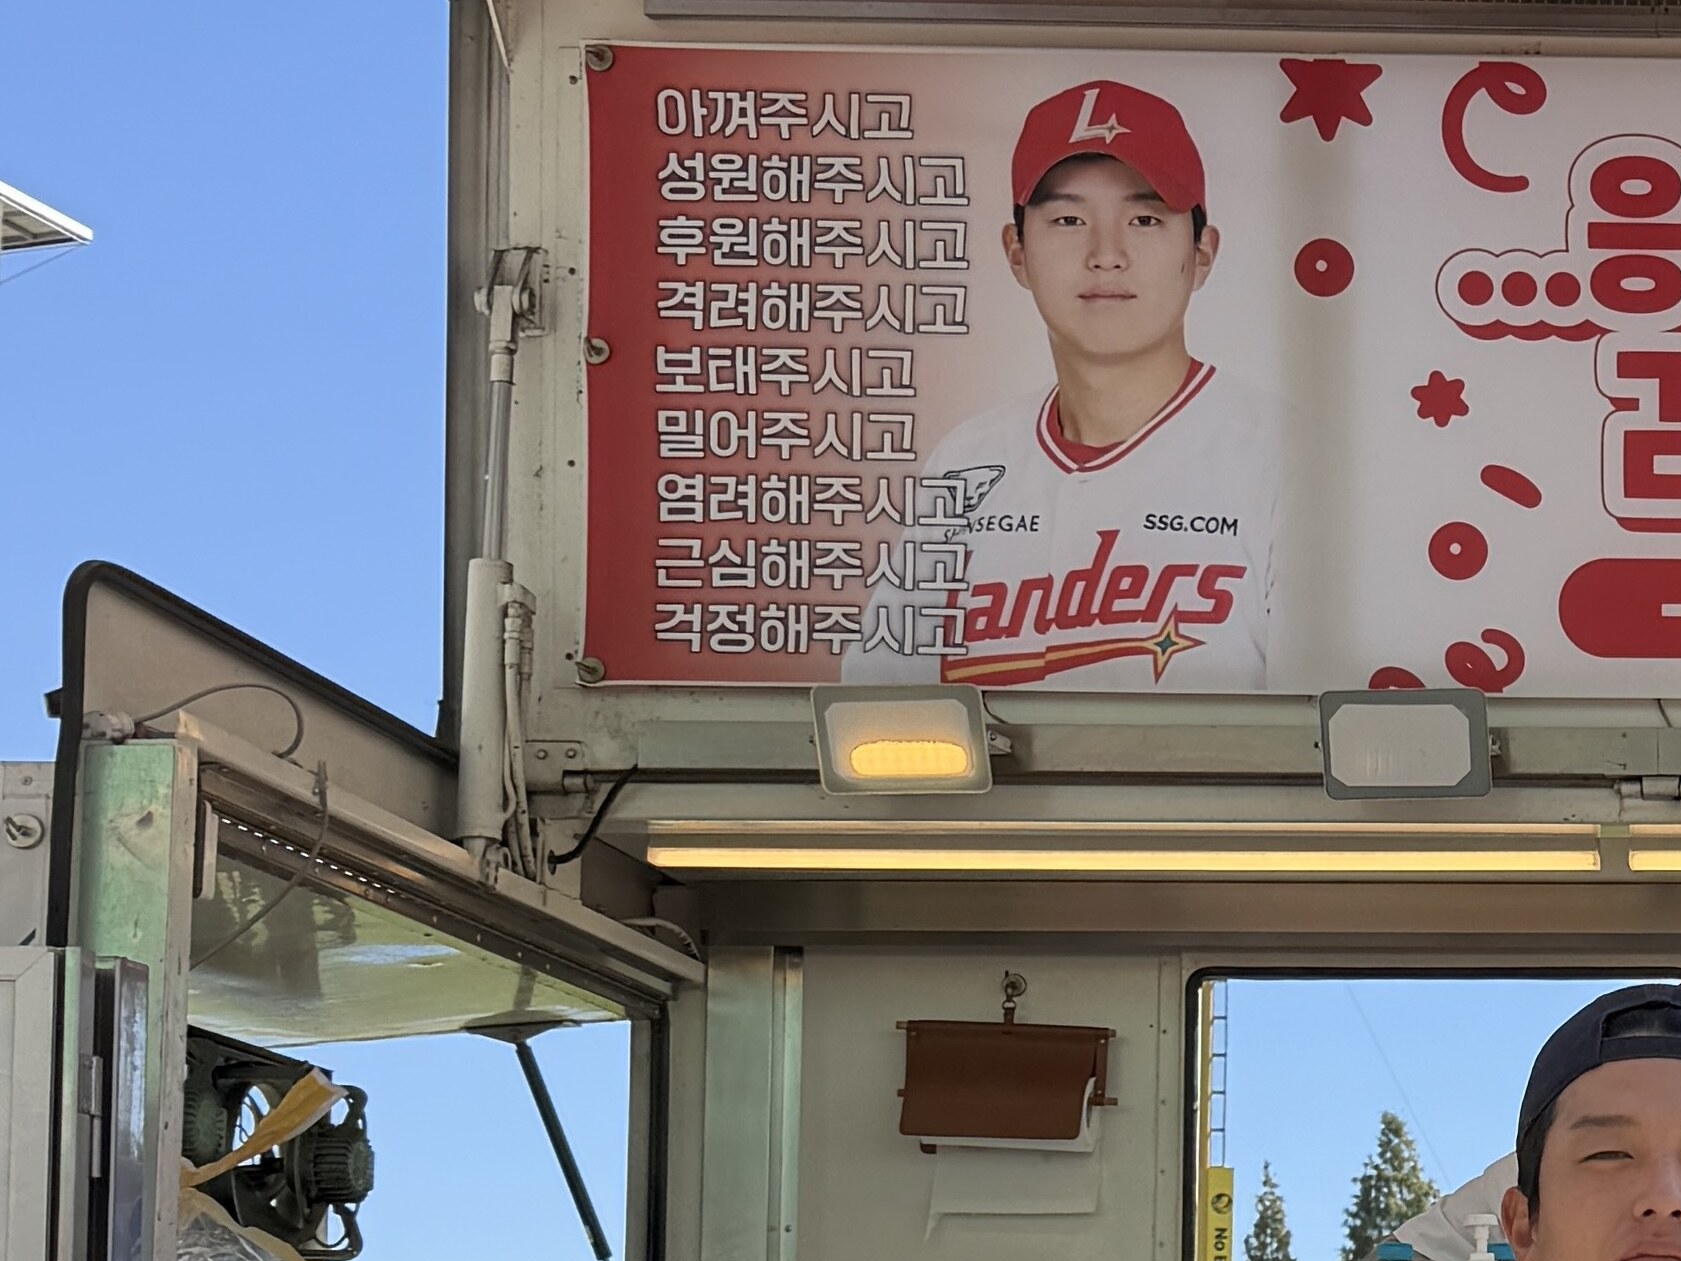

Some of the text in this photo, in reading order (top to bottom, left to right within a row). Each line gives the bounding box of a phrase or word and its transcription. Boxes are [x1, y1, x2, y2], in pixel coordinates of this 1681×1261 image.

[656, 88, 914, 140] 아껴주시고
[657, 152, 970, 206] 성원해주시고
[656, 215, 970, 270] 후원해주시고
[656, 281, 970, 334] 격려해주시고
[655, 345, 917, 397] 보태주시고
[657, 409, 917, 461] 밀어주시고
[657, 473, 969, 526] 염려해주시고
[1143, 514, 1239, 537] SSG.COM
[655, 538, 969, 591] 근심해주시고
[654, 603, 968, 656] 걱정해주시고
[1213, 1227, 1229, 1252] No
